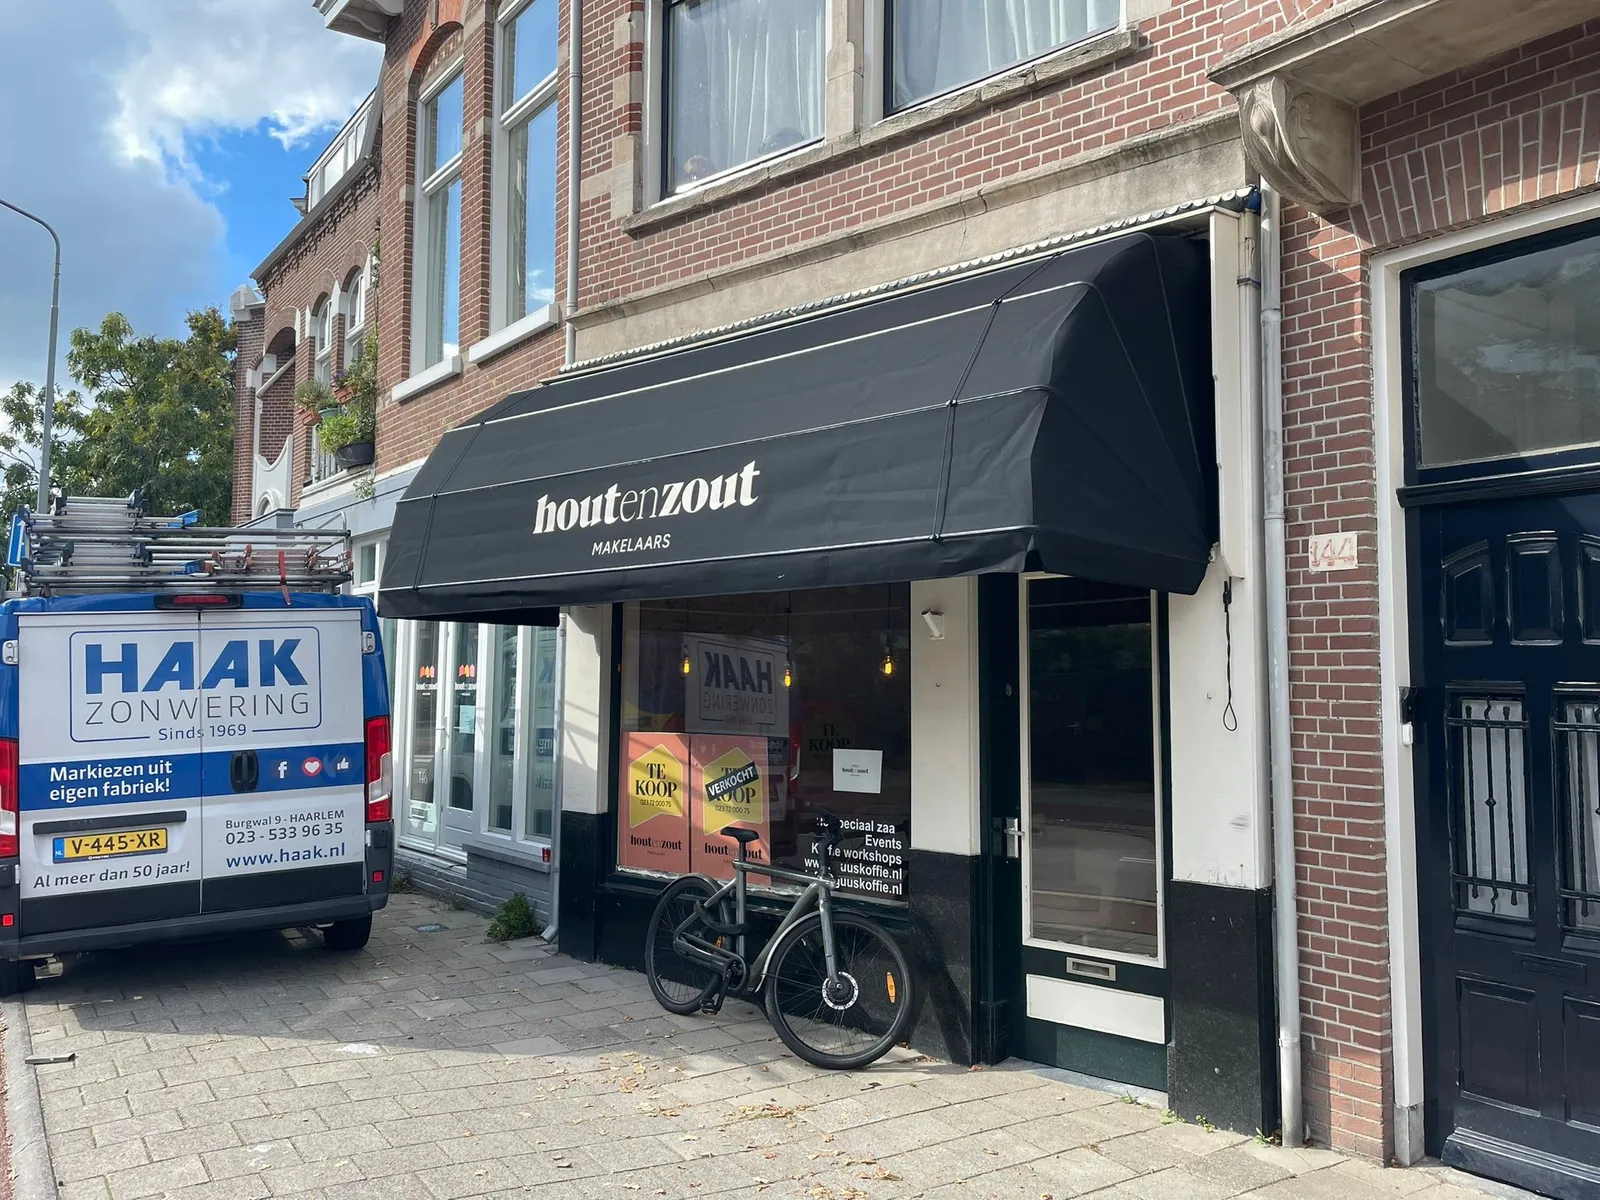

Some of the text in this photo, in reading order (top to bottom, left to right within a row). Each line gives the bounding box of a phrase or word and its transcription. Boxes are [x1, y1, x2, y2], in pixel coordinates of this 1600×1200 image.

[532, 460, 760, 534] houtenzout
[592, 533, 671, 556] MAKELAARS
[85, 638, 308, 694] HAAK
[85, 692, 309, 725] ZONWERING
[159, 723, 247, 741] Sinds 1969
[50, 760, 173, 782] Markiezen uit
[646, 763, 666, 779] TE
[708, 766, 754, 796] VERKOCHT
[49, 777, 170, 803] eigen fabriek!
[635, 779, 678, 798] KOOP
[717, 787, 756, 804] OOP
[225, 816, 272, 830] Burgwal
[274, 815, 281, 824] 9
[290, 810, 345, 823] HAARLEM
[715, 804, 750, 815] 023 72 000 75
[226, 830, 256, 845] 023
[268, 827, 297, 840] 533
[302, 824, 320, 837] 96
[324, 822, 343, 835] 35
[876, 823, 896, 834] zaa
[71, 832, 161, 855] V-445-XR
[631, 834, 682, 851] houtenzout
[704, 842, 763, 859] houtenout
[865, 834, 902, 850] Events
[226, 842, 345, 868] www.haak.nl
[811, 842, 902, 867] Kfe workshops
[33, 861, 191, 888] Al meer dan 50 jaar!
